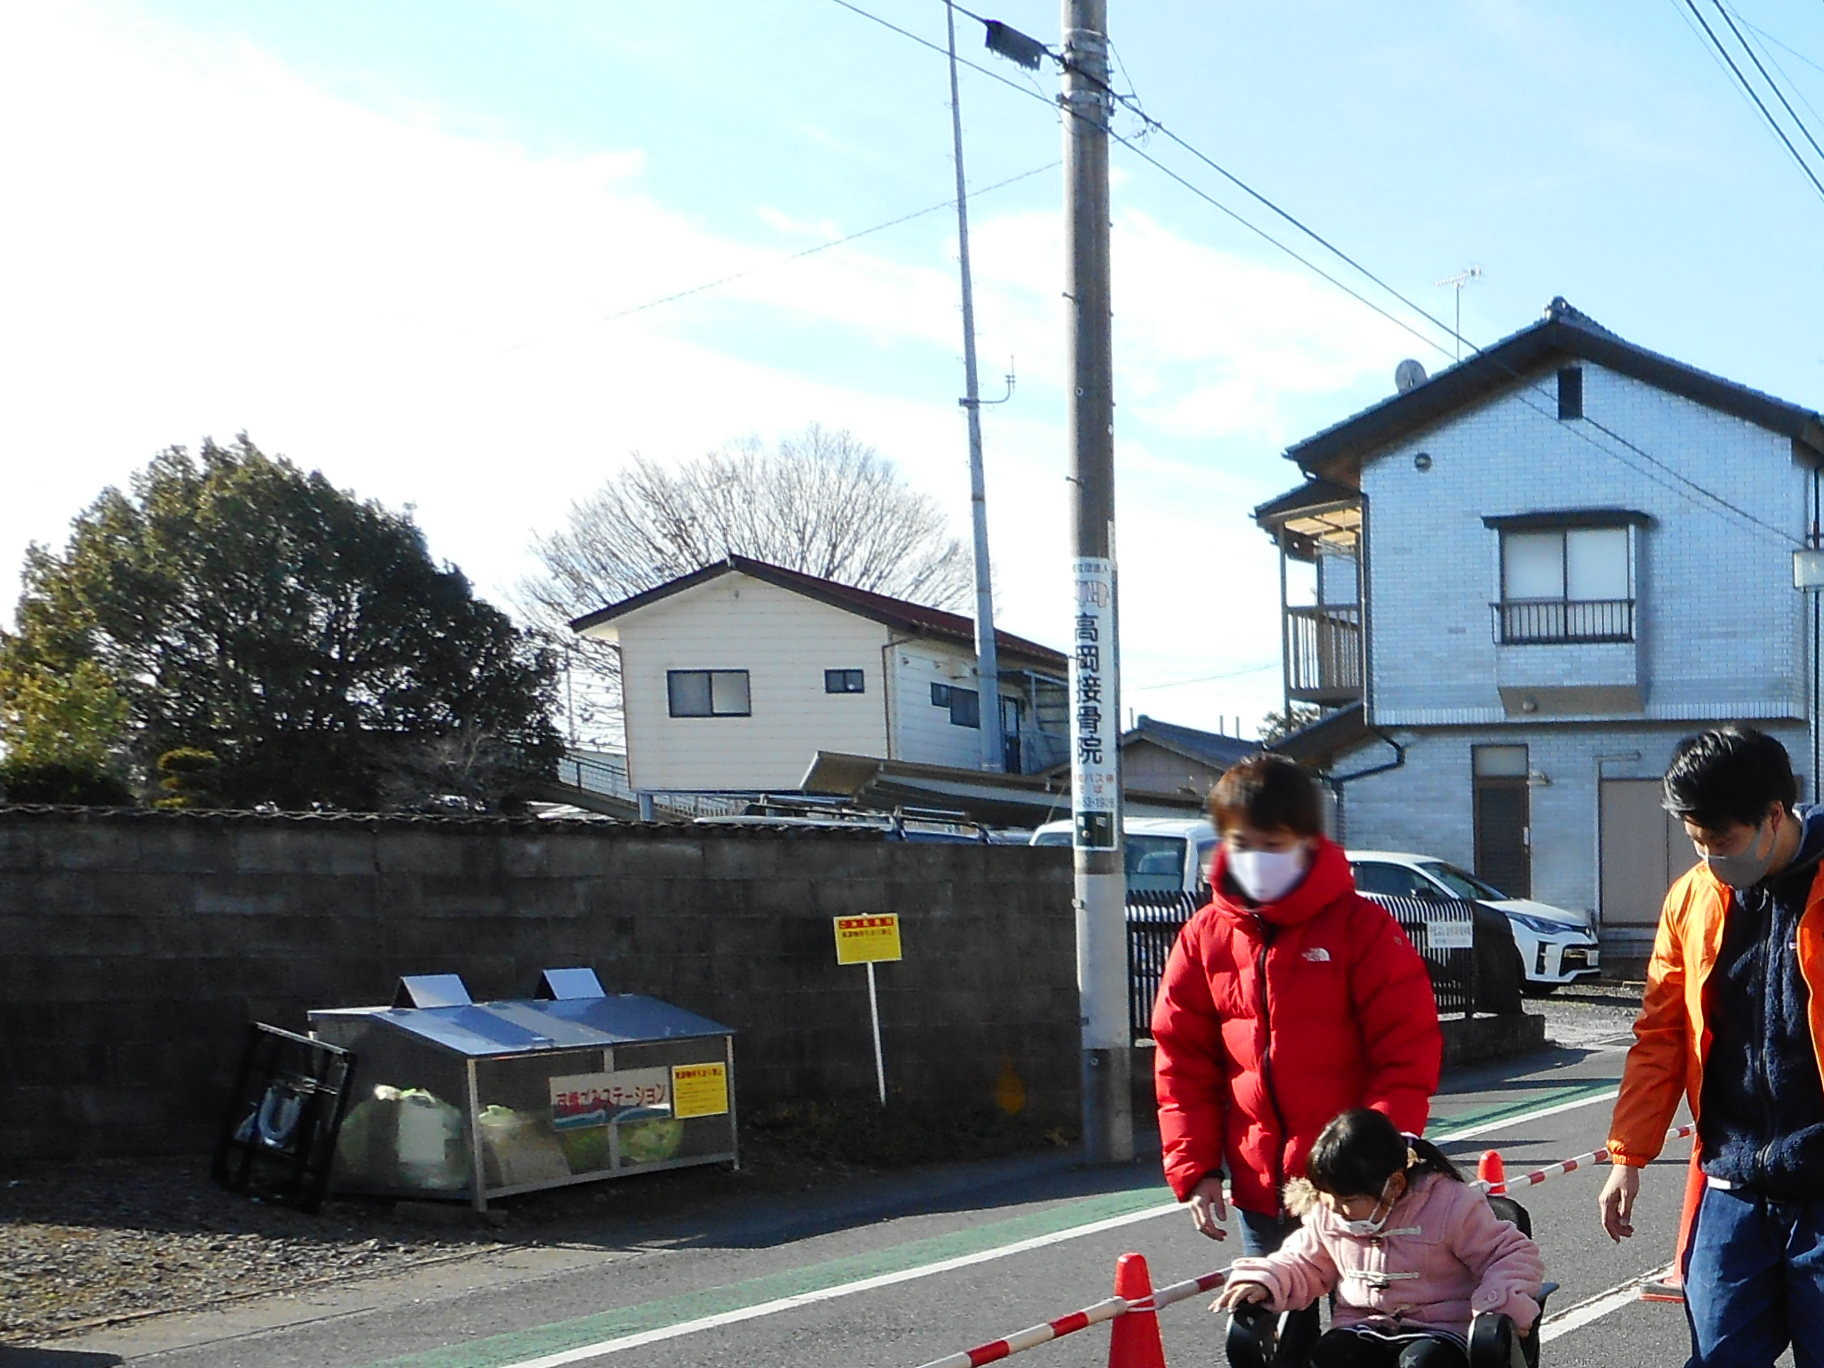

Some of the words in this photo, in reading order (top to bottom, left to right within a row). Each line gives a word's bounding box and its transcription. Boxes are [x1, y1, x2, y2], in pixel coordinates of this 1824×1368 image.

[1074, 611, 1103, 765] 高岡接骨院
